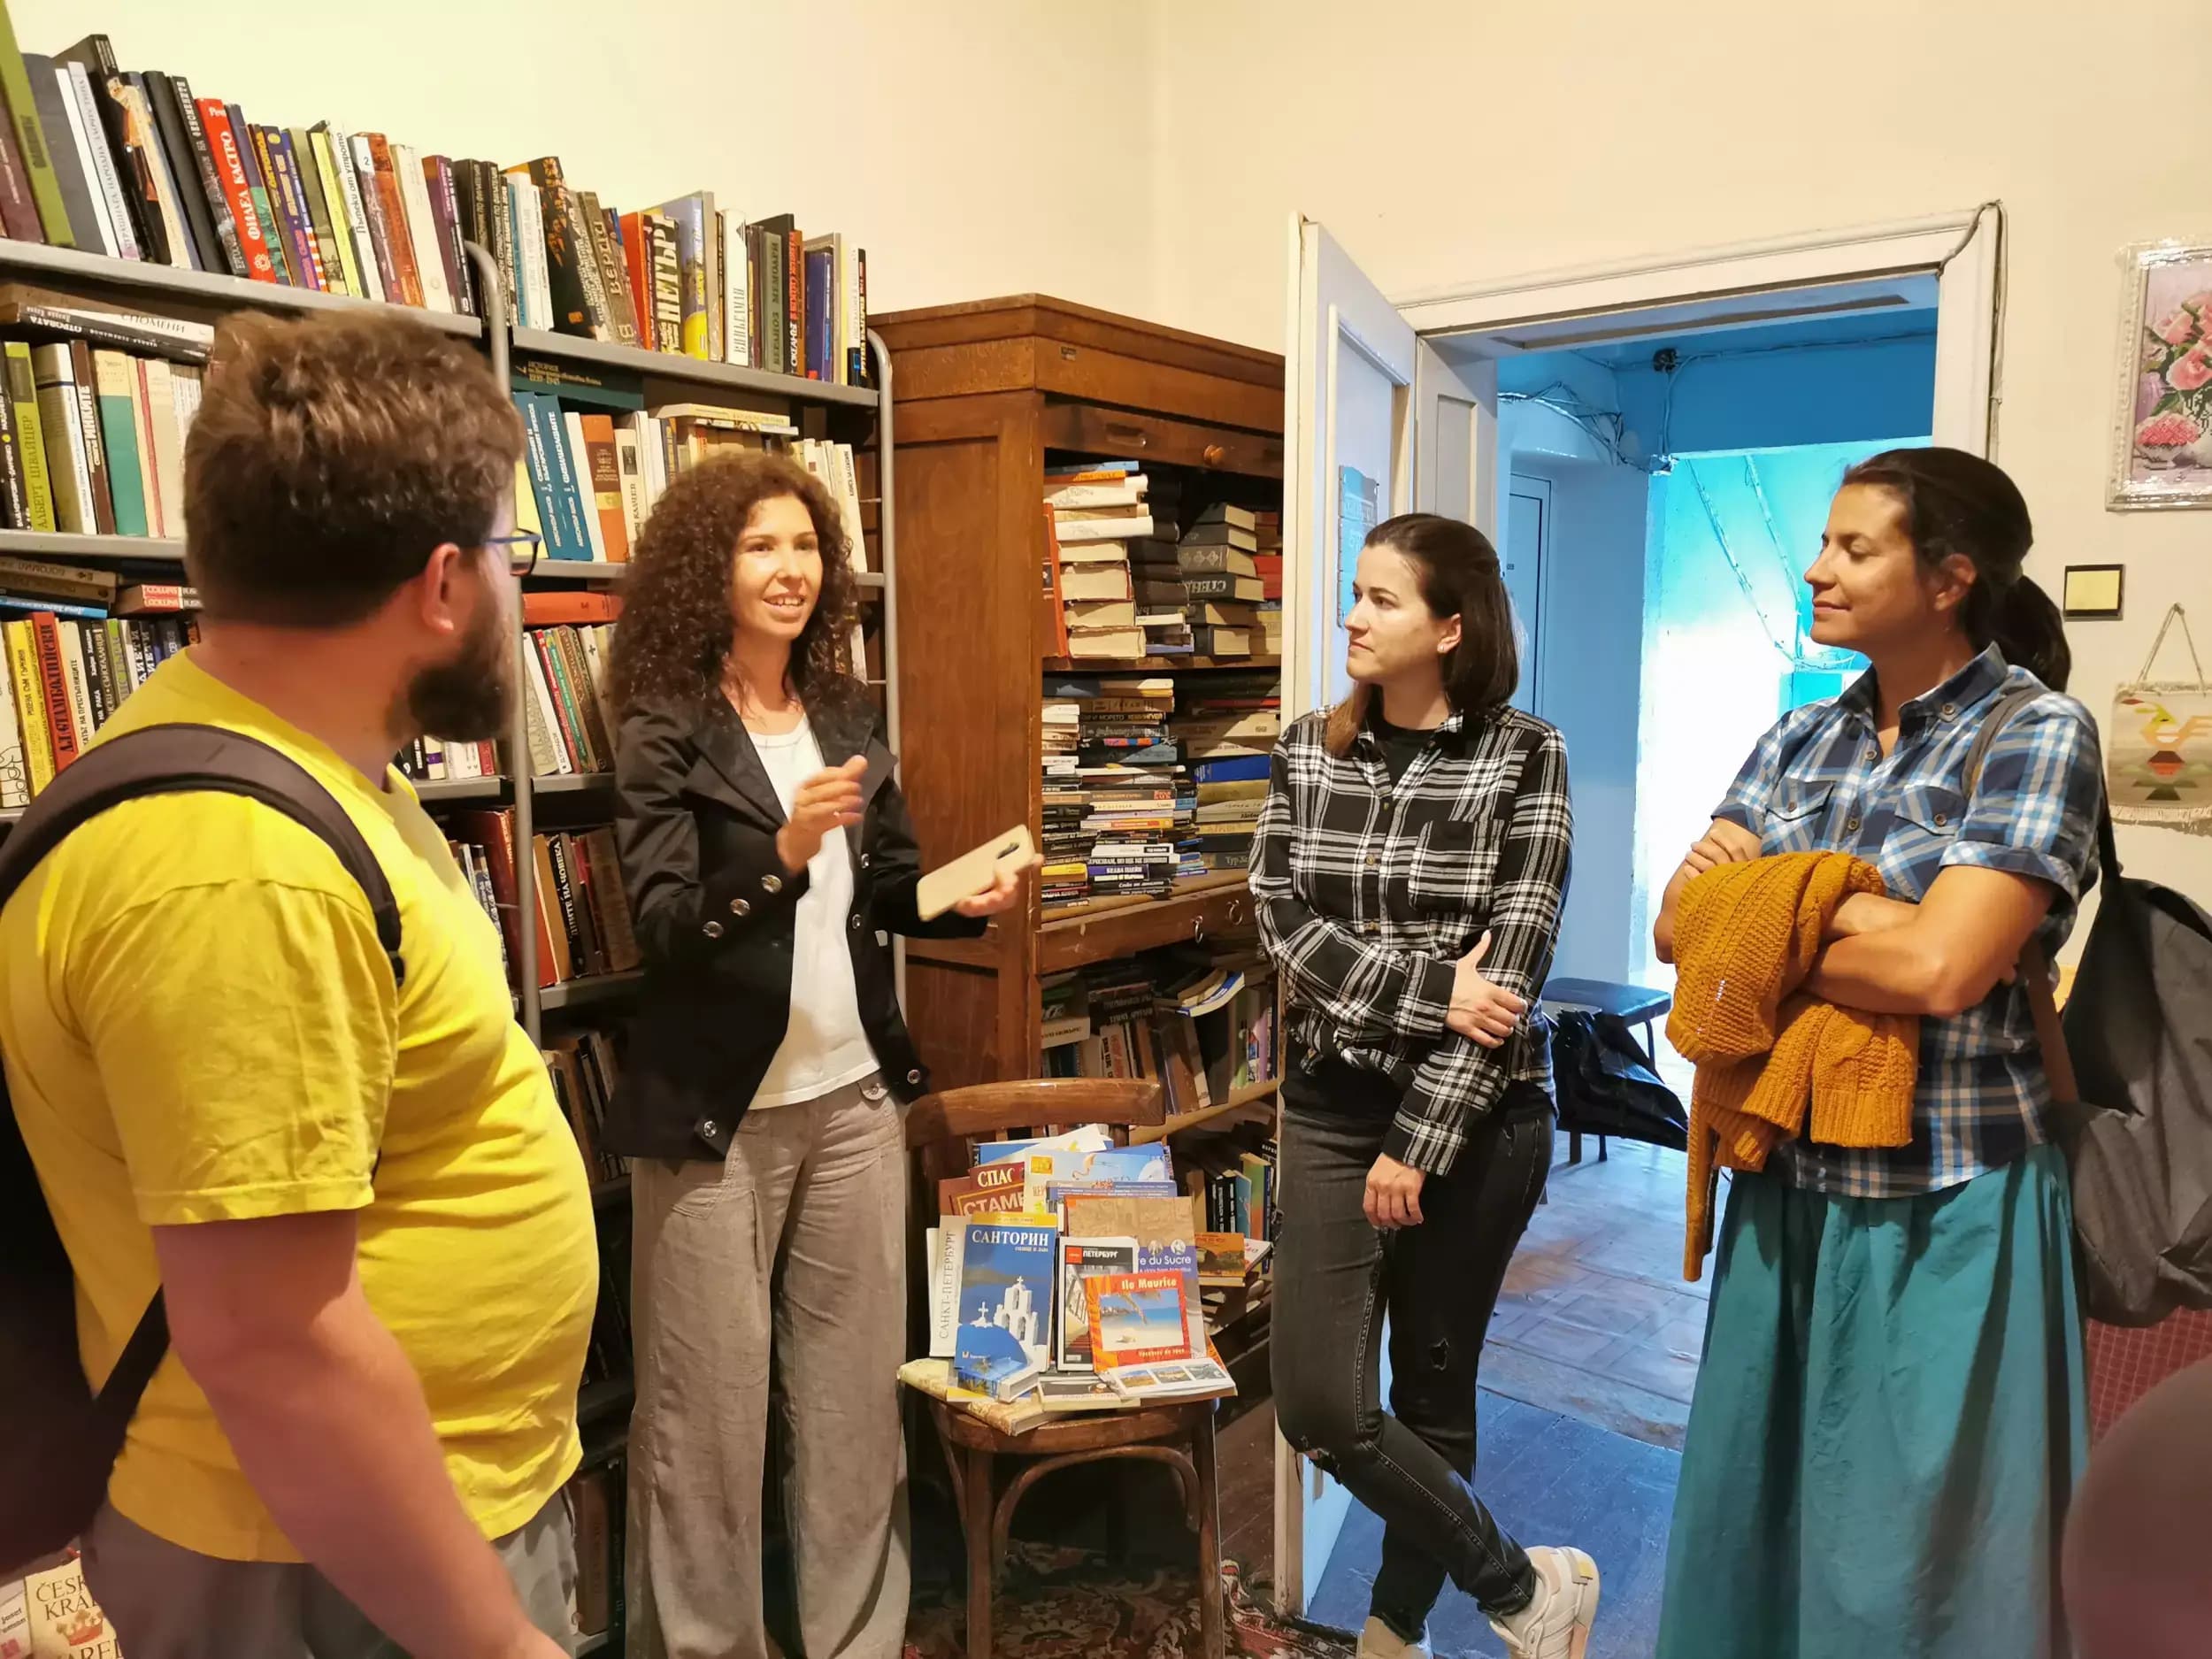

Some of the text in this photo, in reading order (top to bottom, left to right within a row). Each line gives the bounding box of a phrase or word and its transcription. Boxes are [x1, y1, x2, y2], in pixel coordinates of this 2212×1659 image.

[221, 130, 242, 184] КАСТРО
[334, 130, 367, 235] Пътеки от утрото
[234, 188, 263, 242] ФИДЕЛ
[30, 315, 82, 334] ОТРОВАТА
[22, 415, 47, 529] АЛБЕРТ ШВАЙЦЕР
[20, 677, 32, 692] СЪМ
[68, 658, 86, 715] ПРЕСТЪПНИЦИТЕ
[23, 693, 36, 716] РОДЕНА
[93, 688, 103, 708] РАКА
[551, 841, 568, 883] ЧОВЕКА
[560, 882, 572, 899] НА
[977, 1168, 1016, 1187] СПАС
[972, 1230, 1049, 1247] САНТОРИН
[1083, 1248, 1118, 1258] ПЕТЕРБУРГ
[1148, 1256, 1162, 1265] du
[1164, 1256, 1192, 1265] Sucre
[941, 1231, 956, 1338] САНКТ-ПЕТЕРБУРГ
[1138, 1277, 1177, 1289] Maurice
